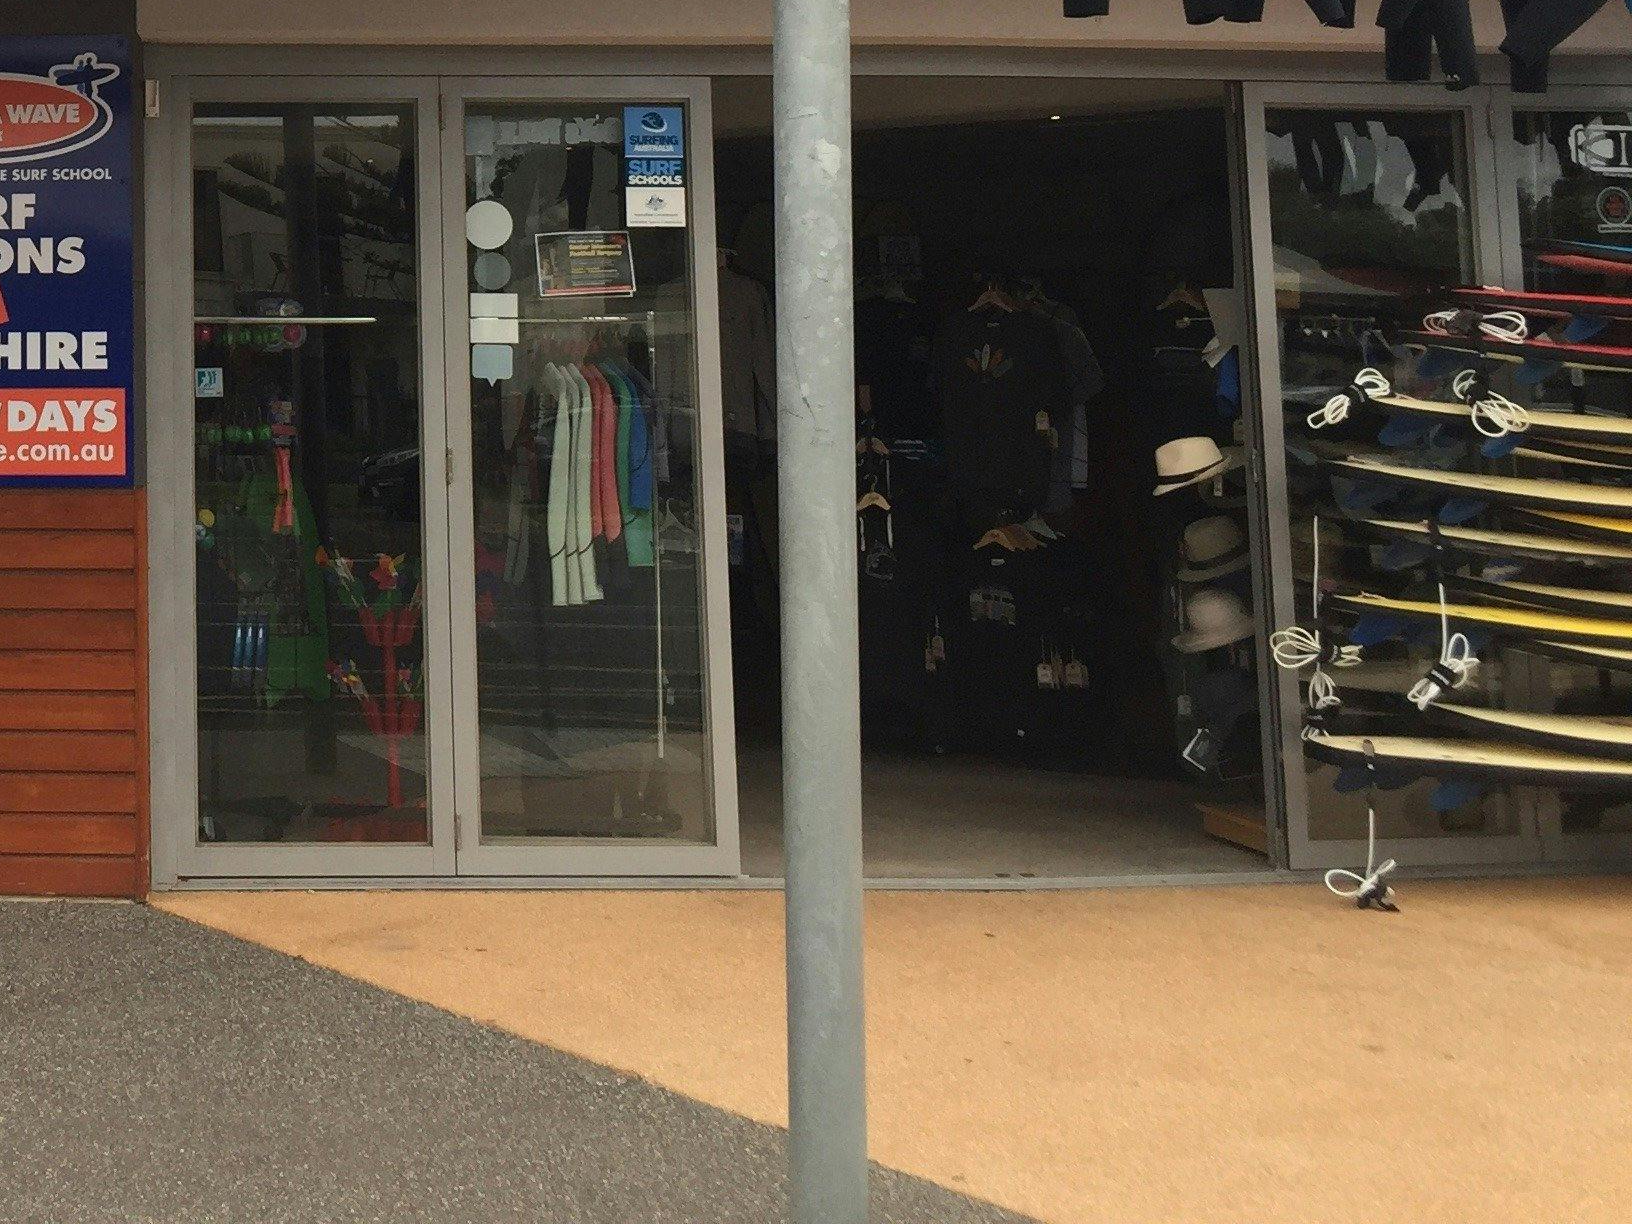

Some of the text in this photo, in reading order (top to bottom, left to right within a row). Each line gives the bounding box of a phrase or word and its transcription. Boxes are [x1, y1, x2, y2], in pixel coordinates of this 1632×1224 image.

[8, 103, 80, 123] WAVE
[629, 135, 679, 146] SURFING
[633, 144, 674, 152] AUSTRALIA
[12, 168, 49, 182] SURF
[52, 167, 112, 181] SCHOOL
[628, 160, 682, 175] SURF
[628, 175, 683, 185] SCHOOLS
[7, 399, 118, 433] DAYS
